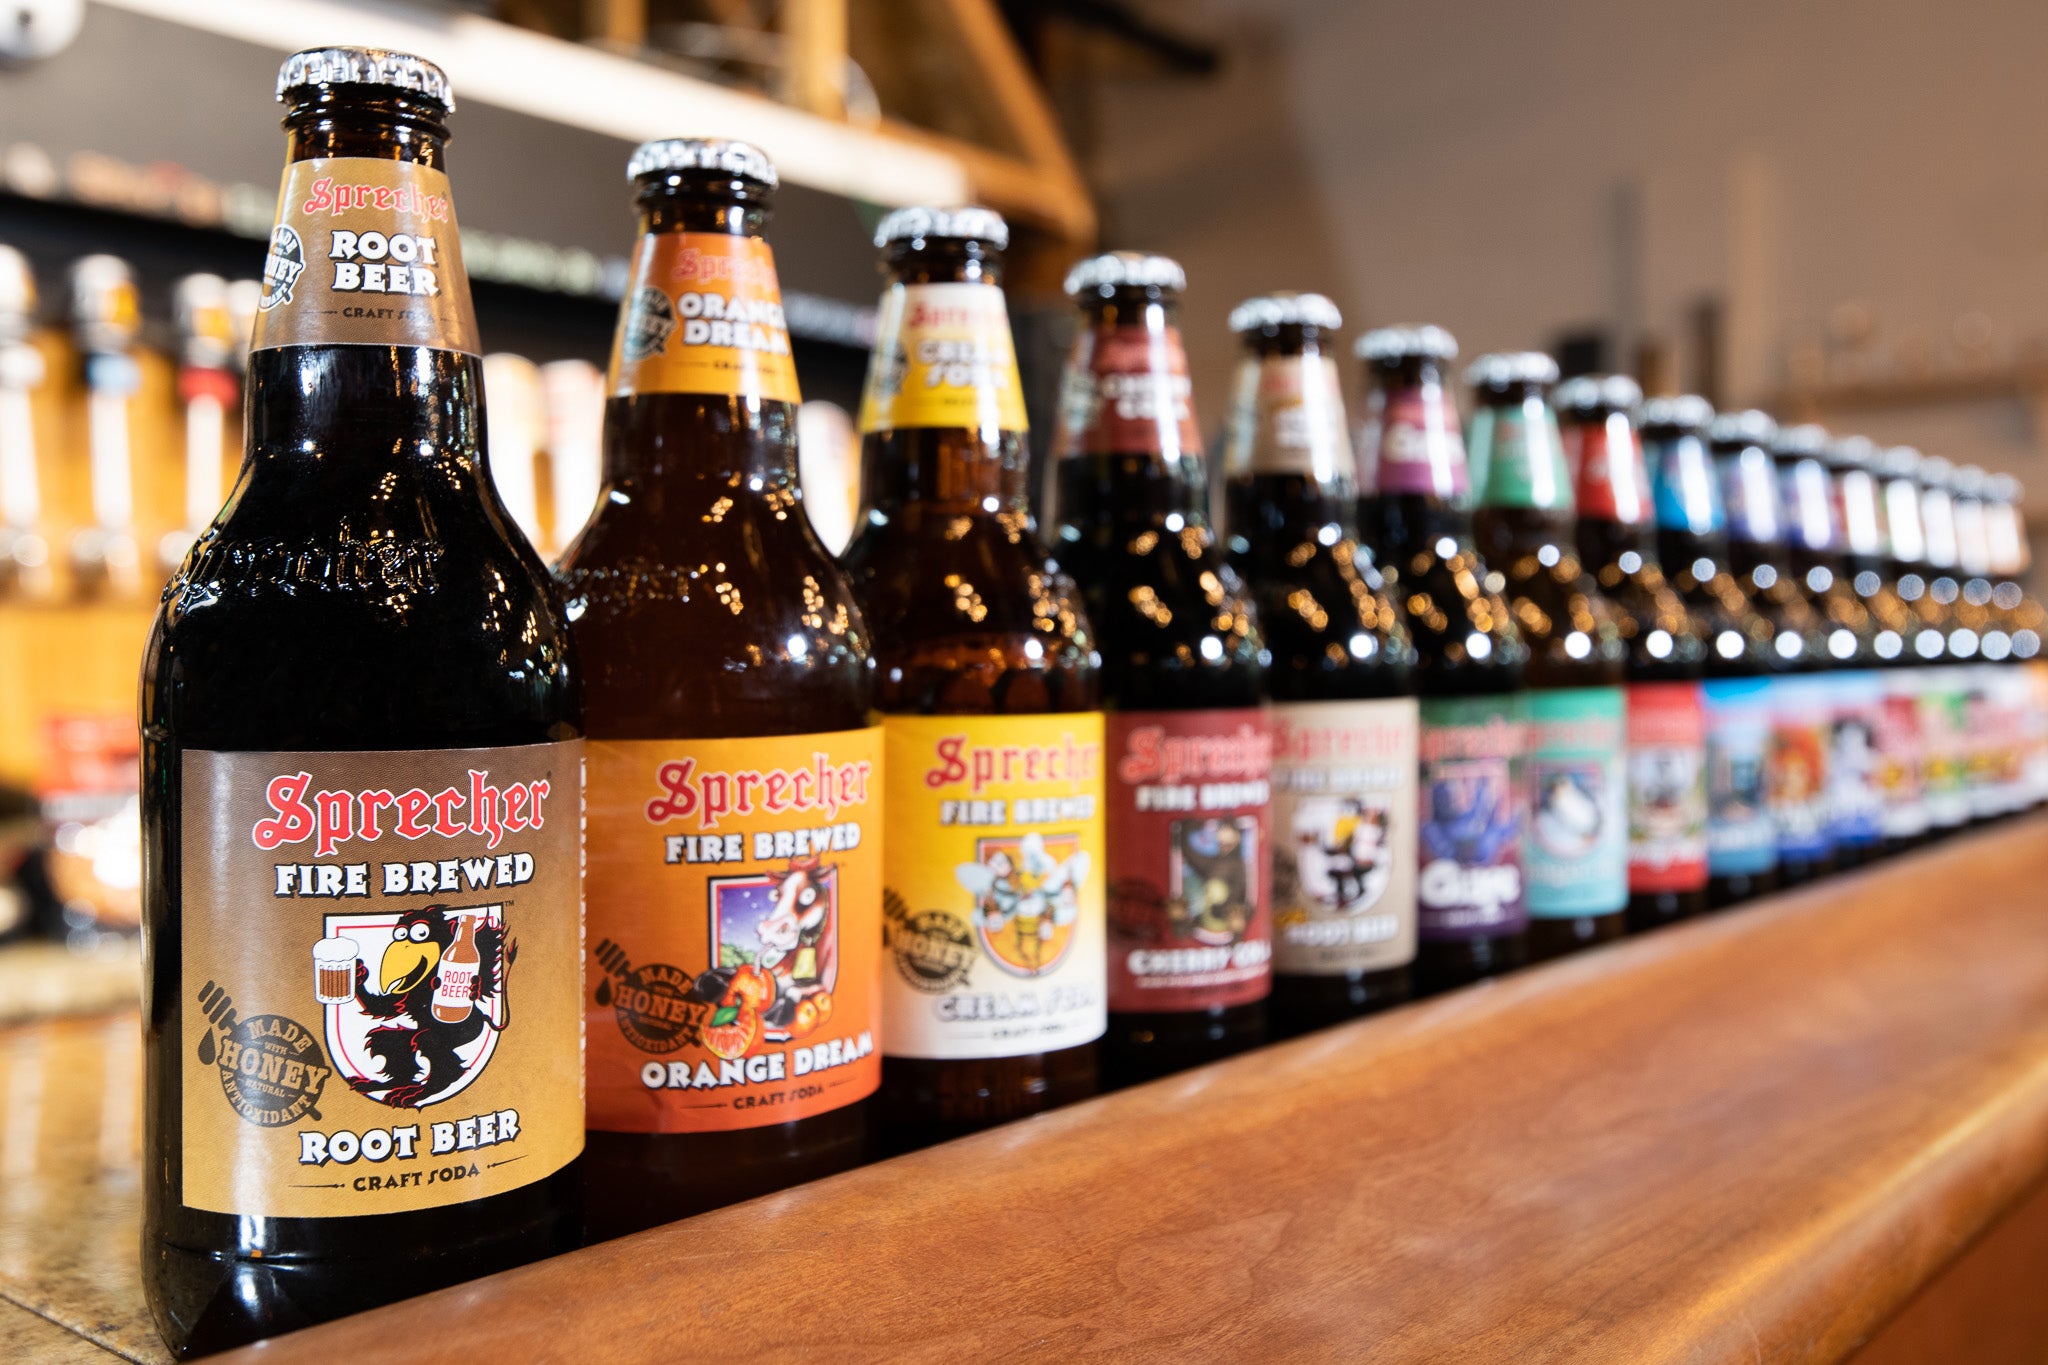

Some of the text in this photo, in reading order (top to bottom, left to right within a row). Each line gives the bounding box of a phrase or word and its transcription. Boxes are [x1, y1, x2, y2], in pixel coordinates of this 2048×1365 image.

[303, 177, 449, 222] Sprecher
[328, 230, 440, 267] ROOT
[331, 262, 442, 298] BEER
[343, 307, 394, 320] CRAFT
[678, 292, 788, 329] ORANG
[684, 319, 790, 356] DREAM
[644, 752, 872, 829] Sprecher
[252, 769, 550, 857] Sprecher
[940, 799, 1006, 825] FIRE
[664, 822, 862, 865] FIRE BREWED
[274, 852, 536, 899] FIRE BREWED
[441, 984, 470, 998] BEER
[444, 970, 472, 984] ROOT
[638, 966, 693, 996] MADE
[615, 984, 708, 1027] HONEY
[247, 1018, 313, 1053] MADE
[218, 1038, 329, 1095] HONEY
[640, 1030, 874, 1089] ORANGE DREAM
[245, 1078, 286, 1098] NATURAL
[733, 1084, 824, 1110] CRAFT SODA
[298, 1107, 521, 1167] ROOT BEER
[352, 1162, 480, 1193] CRAFT SODA
